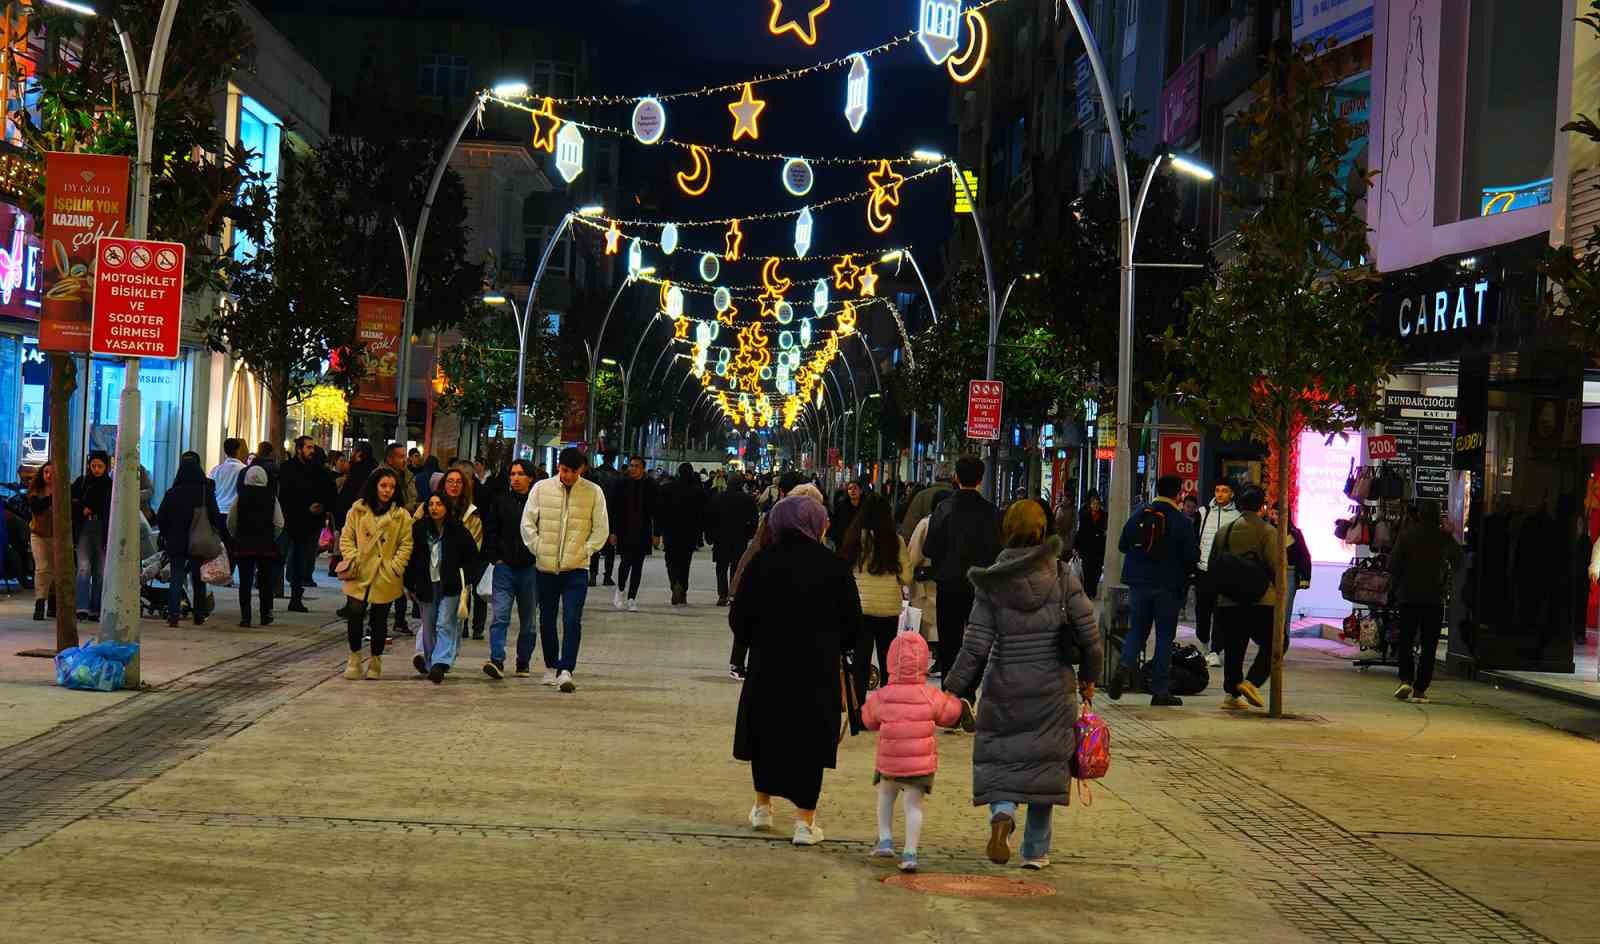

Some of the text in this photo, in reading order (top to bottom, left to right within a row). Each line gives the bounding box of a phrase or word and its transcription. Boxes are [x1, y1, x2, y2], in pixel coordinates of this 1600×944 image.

[96, 199, 119, 214] YOK
[52, 213, 95, 230] KAZANÇ
[101, 272, 177, 287] MOTOSİKLET
[111, 285, 165, 299] BİSİKLET
[129, 301, 145, 311] VE
[1399, 280, 1488, 336] CARAT
[108, 312, 164, 326] SCOOTER
[110, 325, 160, 339] GİRMESİ
[105, 339, 164, 352] YASAKTIR
[1169, 441, 1200, 462] 10
[1176, 462, 1194, 473] GB
